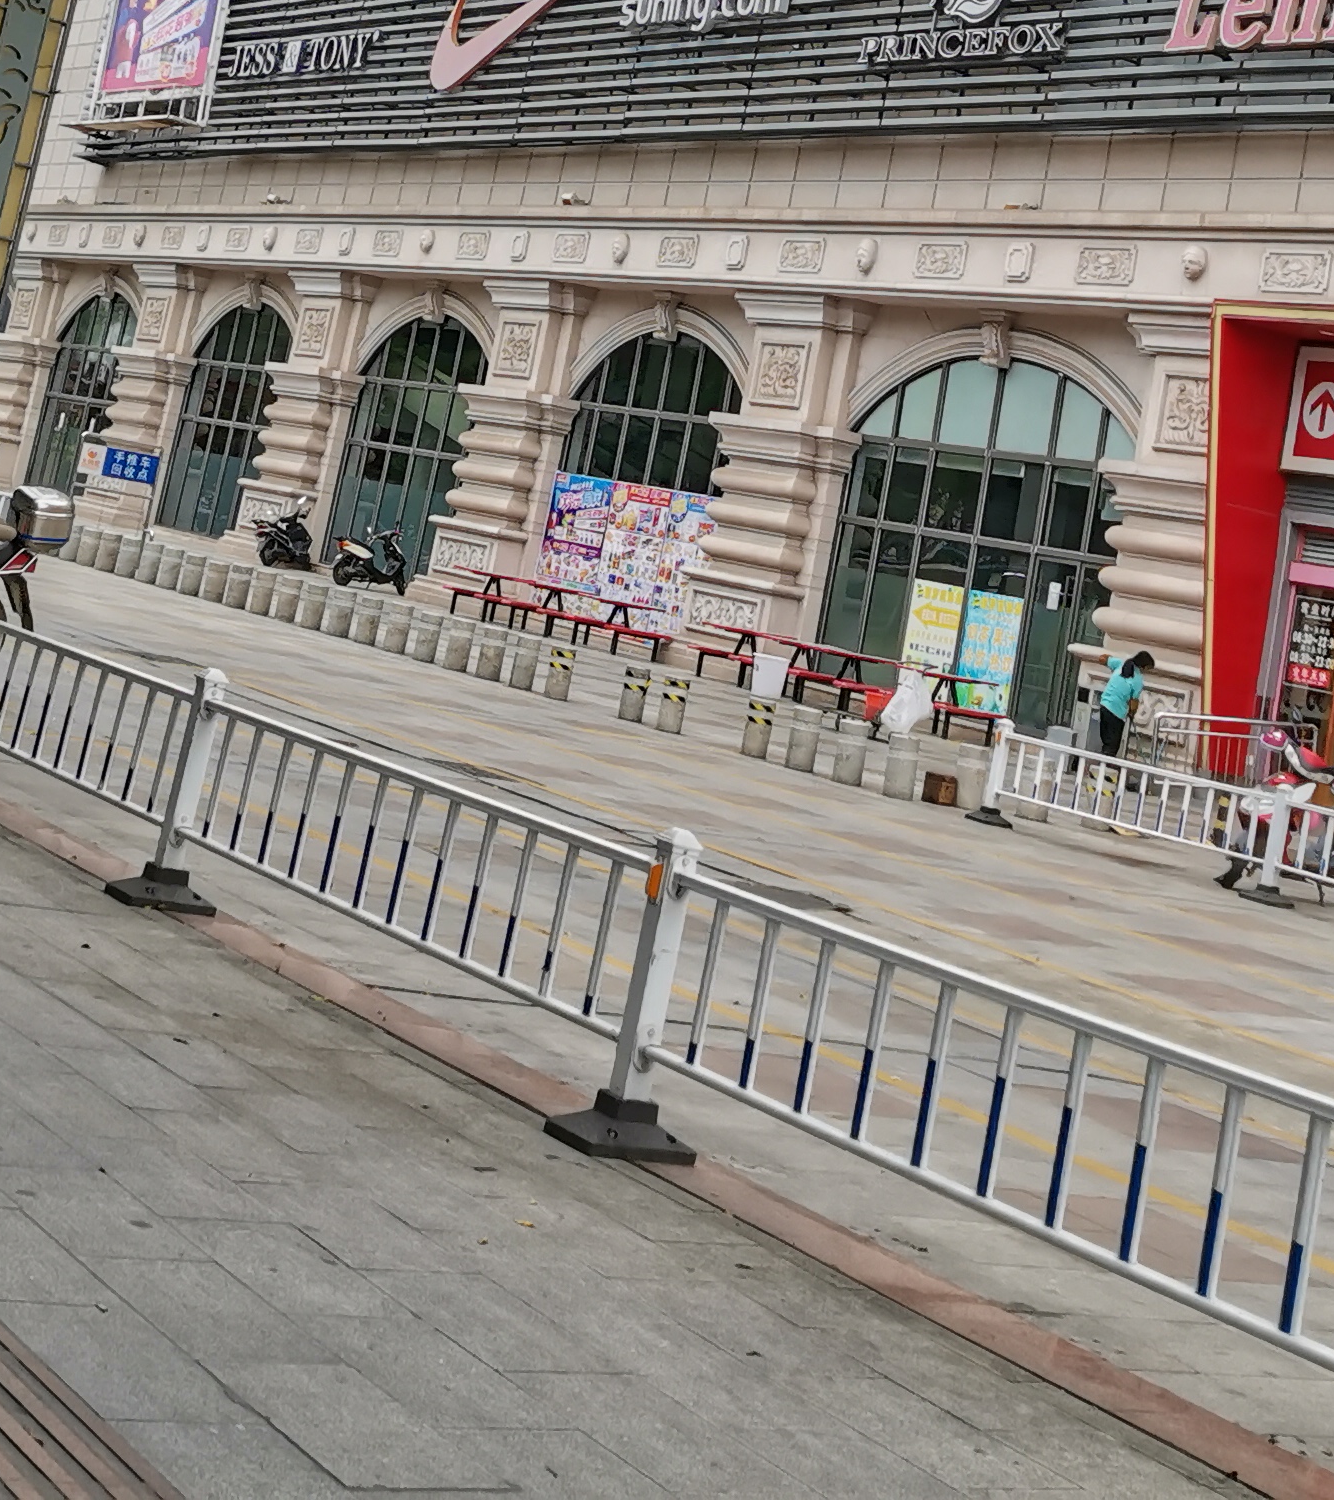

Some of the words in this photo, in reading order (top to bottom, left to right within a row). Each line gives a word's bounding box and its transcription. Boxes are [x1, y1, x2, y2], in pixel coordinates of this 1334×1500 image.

[113, 451, 151, 468] 手推车
[110, 463, 149, 481] 回收点
